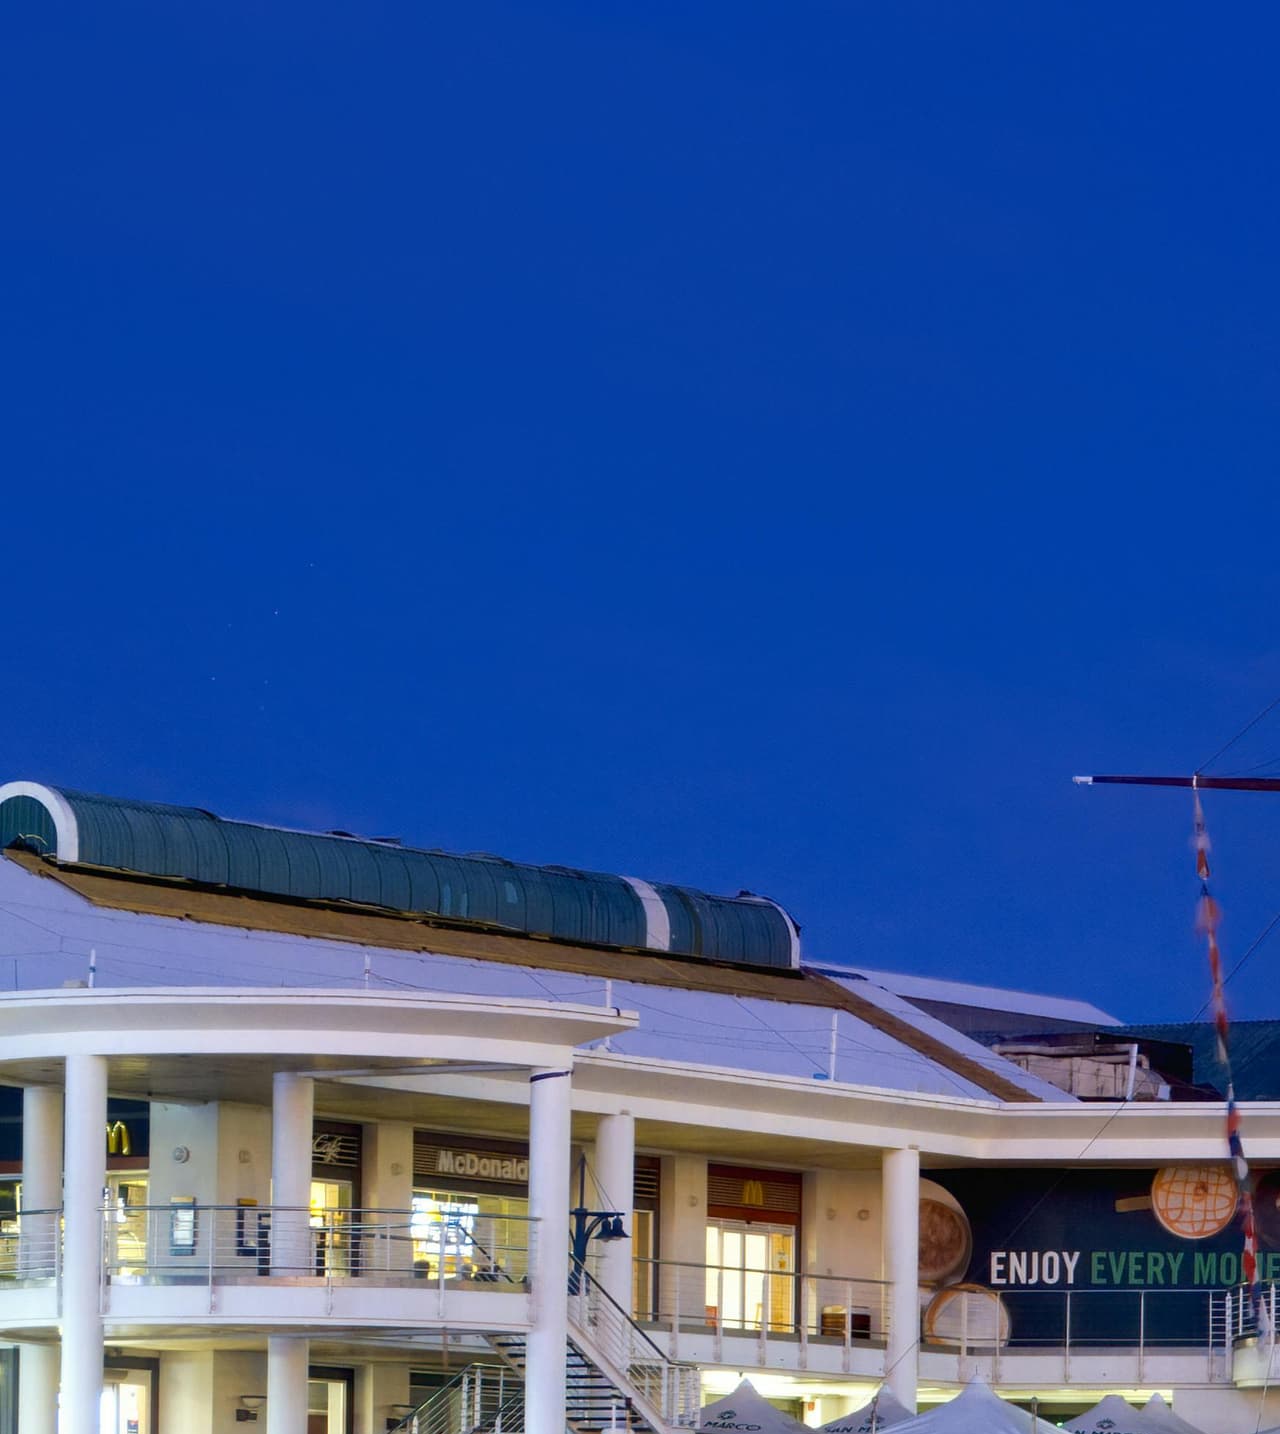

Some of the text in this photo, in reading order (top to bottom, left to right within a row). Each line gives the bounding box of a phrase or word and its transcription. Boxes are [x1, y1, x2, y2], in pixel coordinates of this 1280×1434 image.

[437, 1150, 529, 1181] McDonald
[990, 1251, 1079, 1284] ENJOY
[1090, 1252, 1183, 1285] EVERY
[704, 1420, 762, 1432] MARCO
